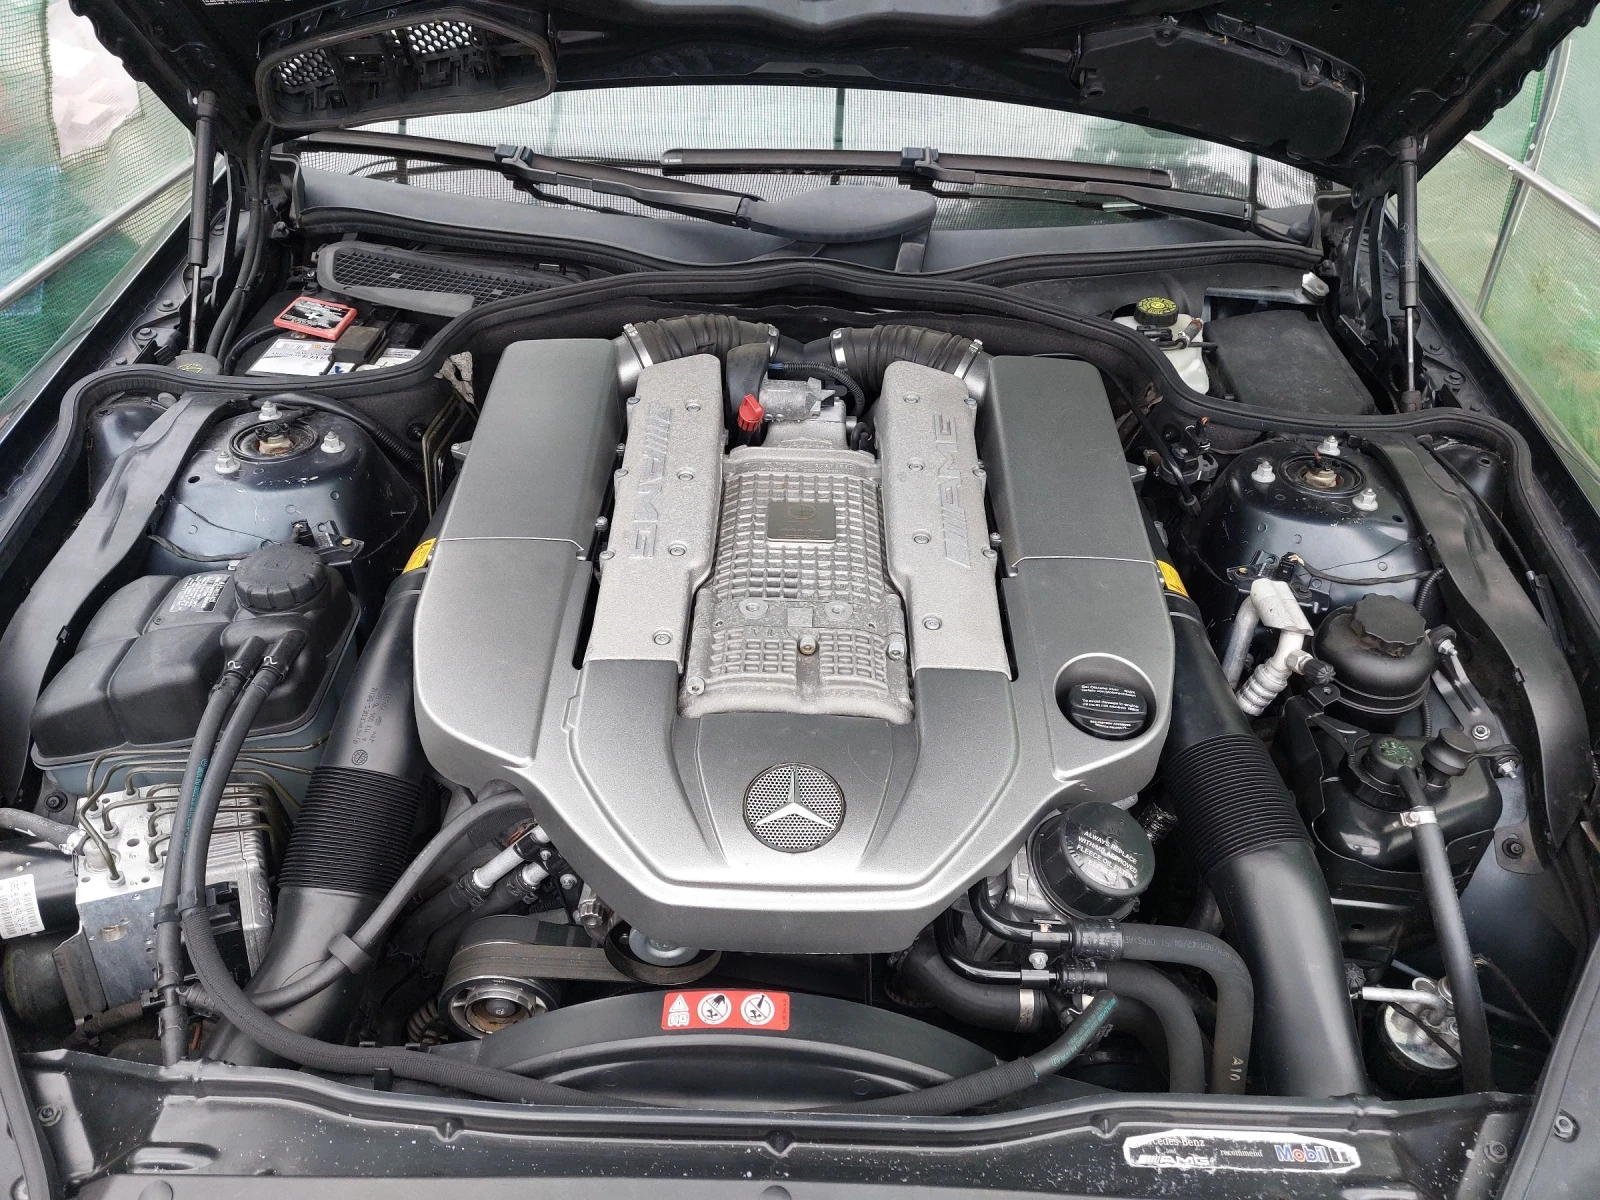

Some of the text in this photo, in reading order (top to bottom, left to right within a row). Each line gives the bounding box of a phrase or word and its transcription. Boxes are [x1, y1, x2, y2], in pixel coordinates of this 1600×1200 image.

[1077, 844, 1102, 861] FLEECE
[1102, 858, 1114, 868] OIL
[1113, 864, 1134, 881] FILTER
[1078, 836, 1095, 849] WITH
[1105, 850, 1138, 874] APPROVED
[1083, 831, 1138, 865] ALWAYS REPLACE
[1087, 860, 1118, 880] ELEMENT
[1158, 1154, 1211, 1166] AMG
[1220, 1149, 1263, 1158] recommend
[1274, 1144, 1330, 1163] Mobil
